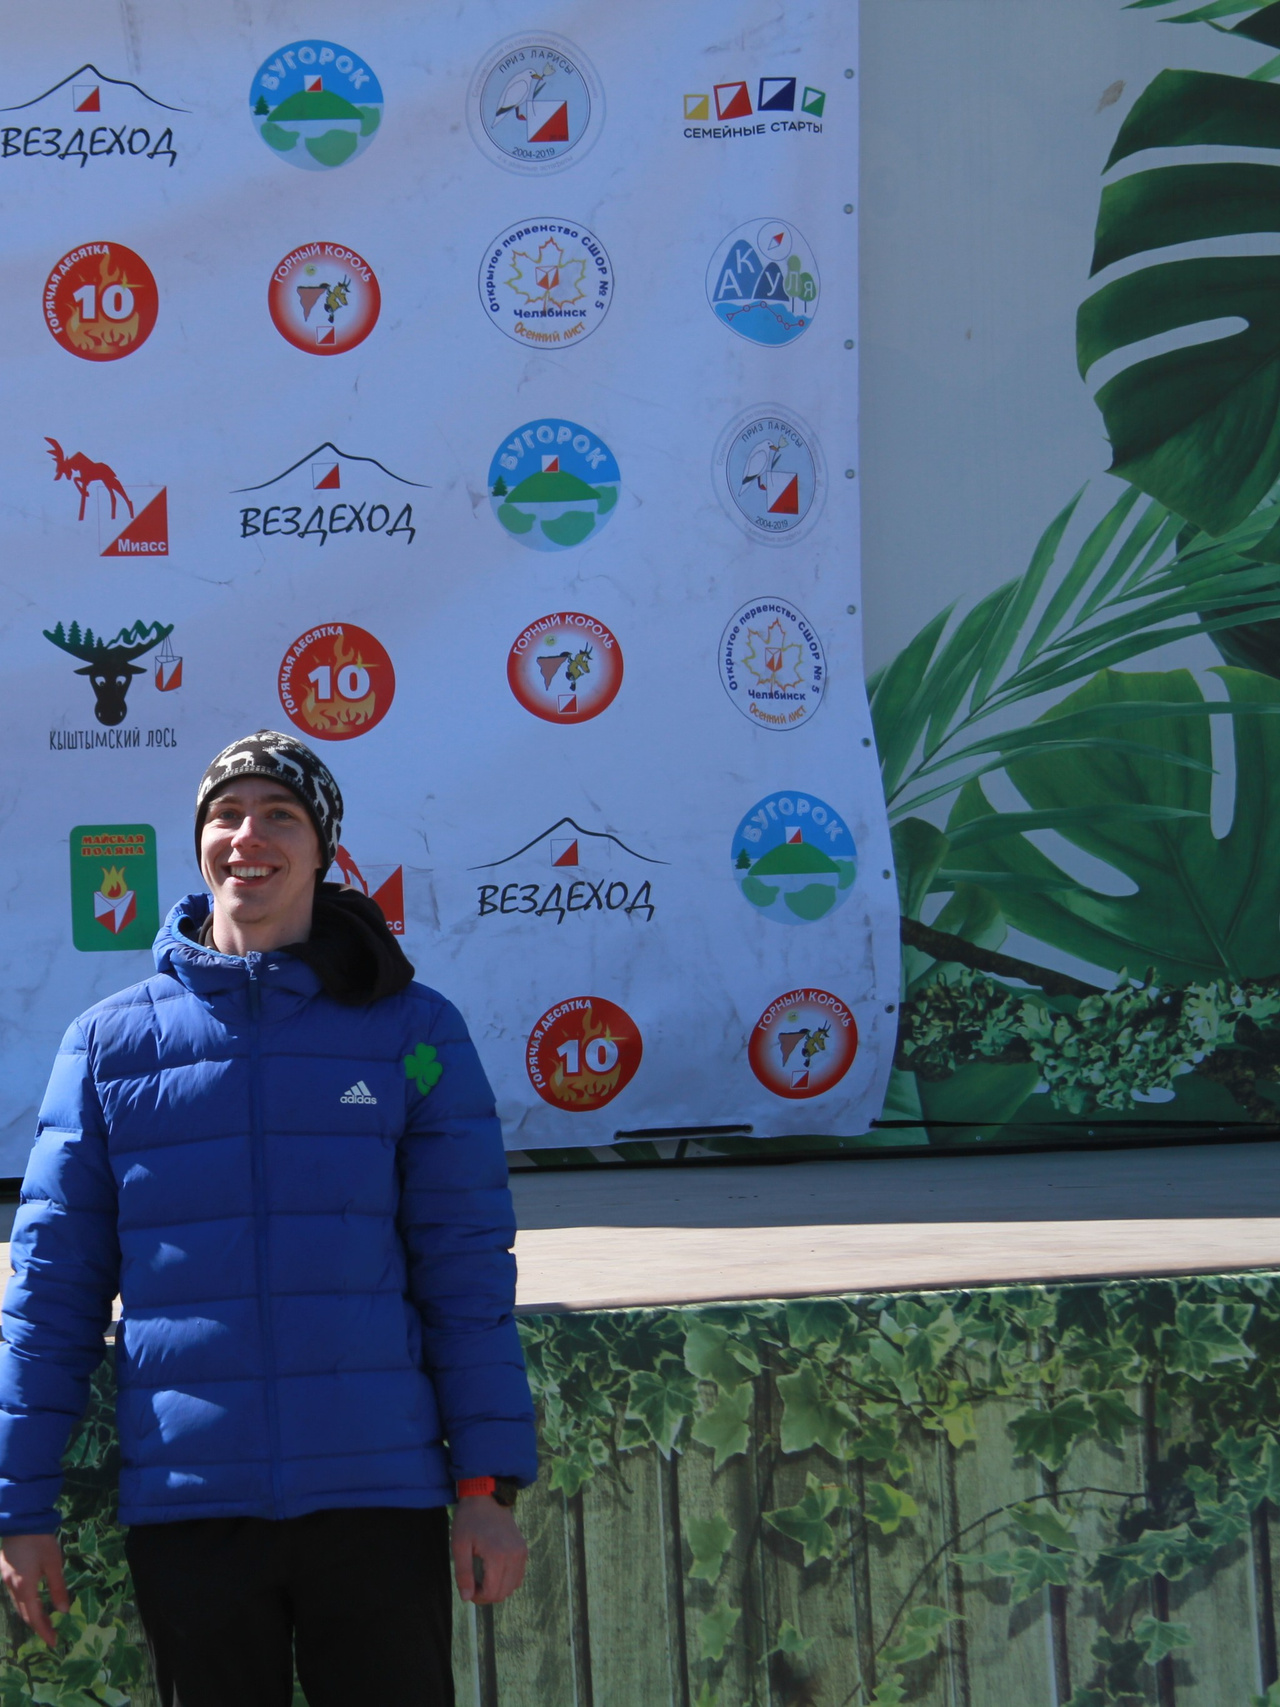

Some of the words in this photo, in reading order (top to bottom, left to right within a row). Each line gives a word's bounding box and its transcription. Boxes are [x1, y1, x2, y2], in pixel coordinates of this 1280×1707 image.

[260, 46, 370, 91] БУГОРОК
[499, 52, 525, 73] ПРИЗ
[531, 50, 574, 75] ЛАРИСЫ
[0, 125, 178, 168] ВЕЗДЕХОД
[683, 124, 765, 138] СЕМЕЙНЫЕ
[770, 121, 823, 134] СТАРТЫ
[512, 147, 555, 159] 2004-2019
[274, 243, 321, 284] ГОРНЫЙ
[325, 245, 373, 282] КОРОЛЬ
[486, 249, 503, 313] Открытое
[502, 224, 578, 248] первенство
[581, 236, 608, 275] СШОР
[45, 273, 63, 335] ГОРЯЧАЯ
[58, 244, 110, 275] ДЕСЯТКА
[73, 284, 135, 320] 10
[513, 308, 587, 318] Челябинск
[499, 425, 607, 471] БУГОРОК
[742, 423, 763, 443] ПРИЗ
[768, 421, 804, 448] ЛАРИСЫ
[240, 502, 417, 546] ВЕЗДЕХОД
[755, 515, 789, 530] 2004-2019
[118, 538, 167, 553] Миасс
[513, 614, 561, 655] ГОРНЫЙ
[565, 614, 615, 649] КОРОЛЬ
[725, 625, 740, 691] Открытое
[739, 604, 797, 626] первенство
[798, 621, 821, 661] СШОР
[280, 655, 299, 715] ГОРЯЧАЯ
[293, 626, 344, 657] ДЕСЯТКА
[308, 664, 370, 699] 10
[748, 689, 806, 700] Челябинск
[741, 797, 843, 842] БУГОРОК
[81, 833, 145, 845] МАЙСКАЯ
[81, 845, 145, 856] ПОЛЯНА
[477, 879, 655, 925] ВЕЗДЕХОД
[758, 990, 805, 1031] ГОРНЫЙ
[808, 991, 852, 1027] КОРОЛЬ
[529, 1029, 546, 1088] ГОРЯЧАЯ
[541, 1000, 592, 1031] ДЕСЯТКА
[556, 1037, 619, 1073] 10
[340, 1094, 378, 1105] adidas
